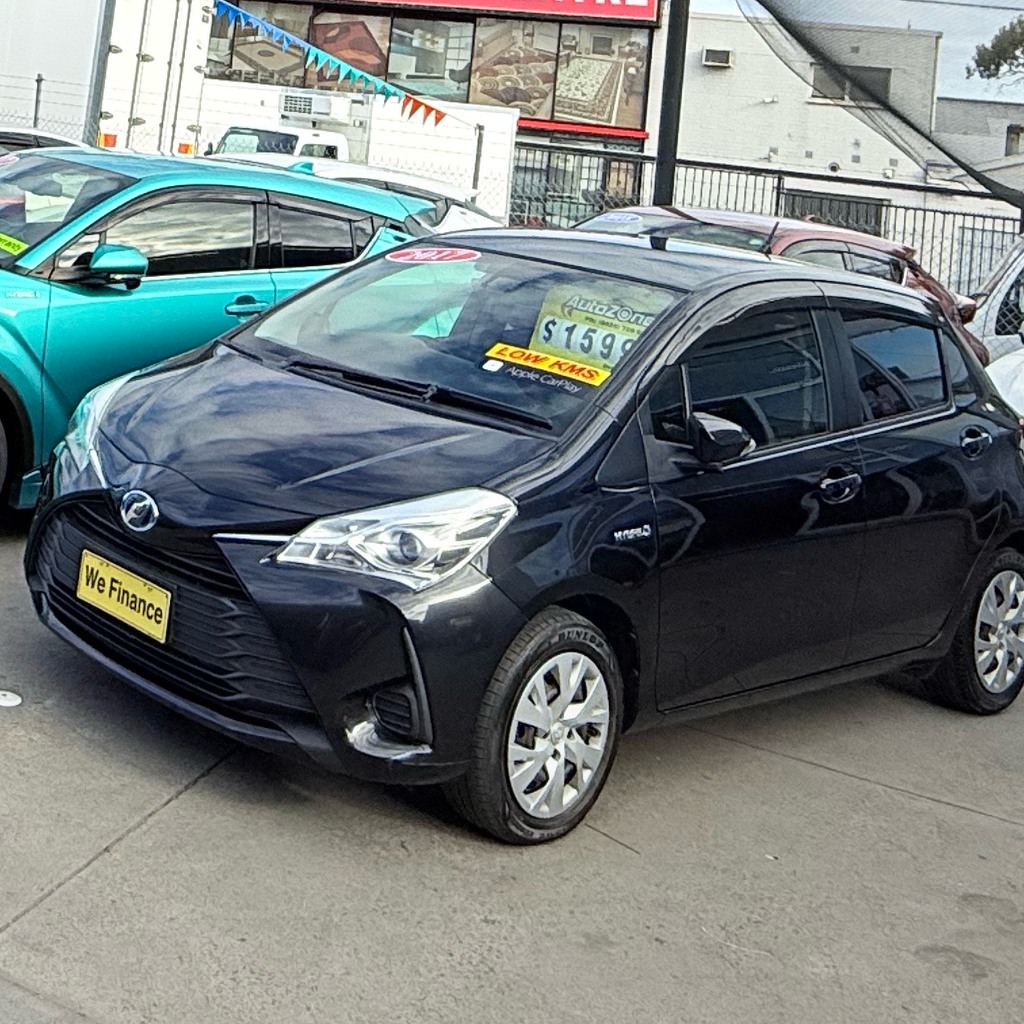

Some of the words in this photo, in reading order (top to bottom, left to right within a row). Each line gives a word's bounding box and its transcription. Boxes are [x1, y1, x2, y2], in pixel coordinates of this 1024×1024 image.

[495, 346, 542, 365] LOW
[547, 357, 600, 382] KMS
[505, 366, 540, 381] Apple
[539, 375, 583, 394] CarPlay
[85, 564, 106, 594] We
[108, 577, 163, 625] Finance
